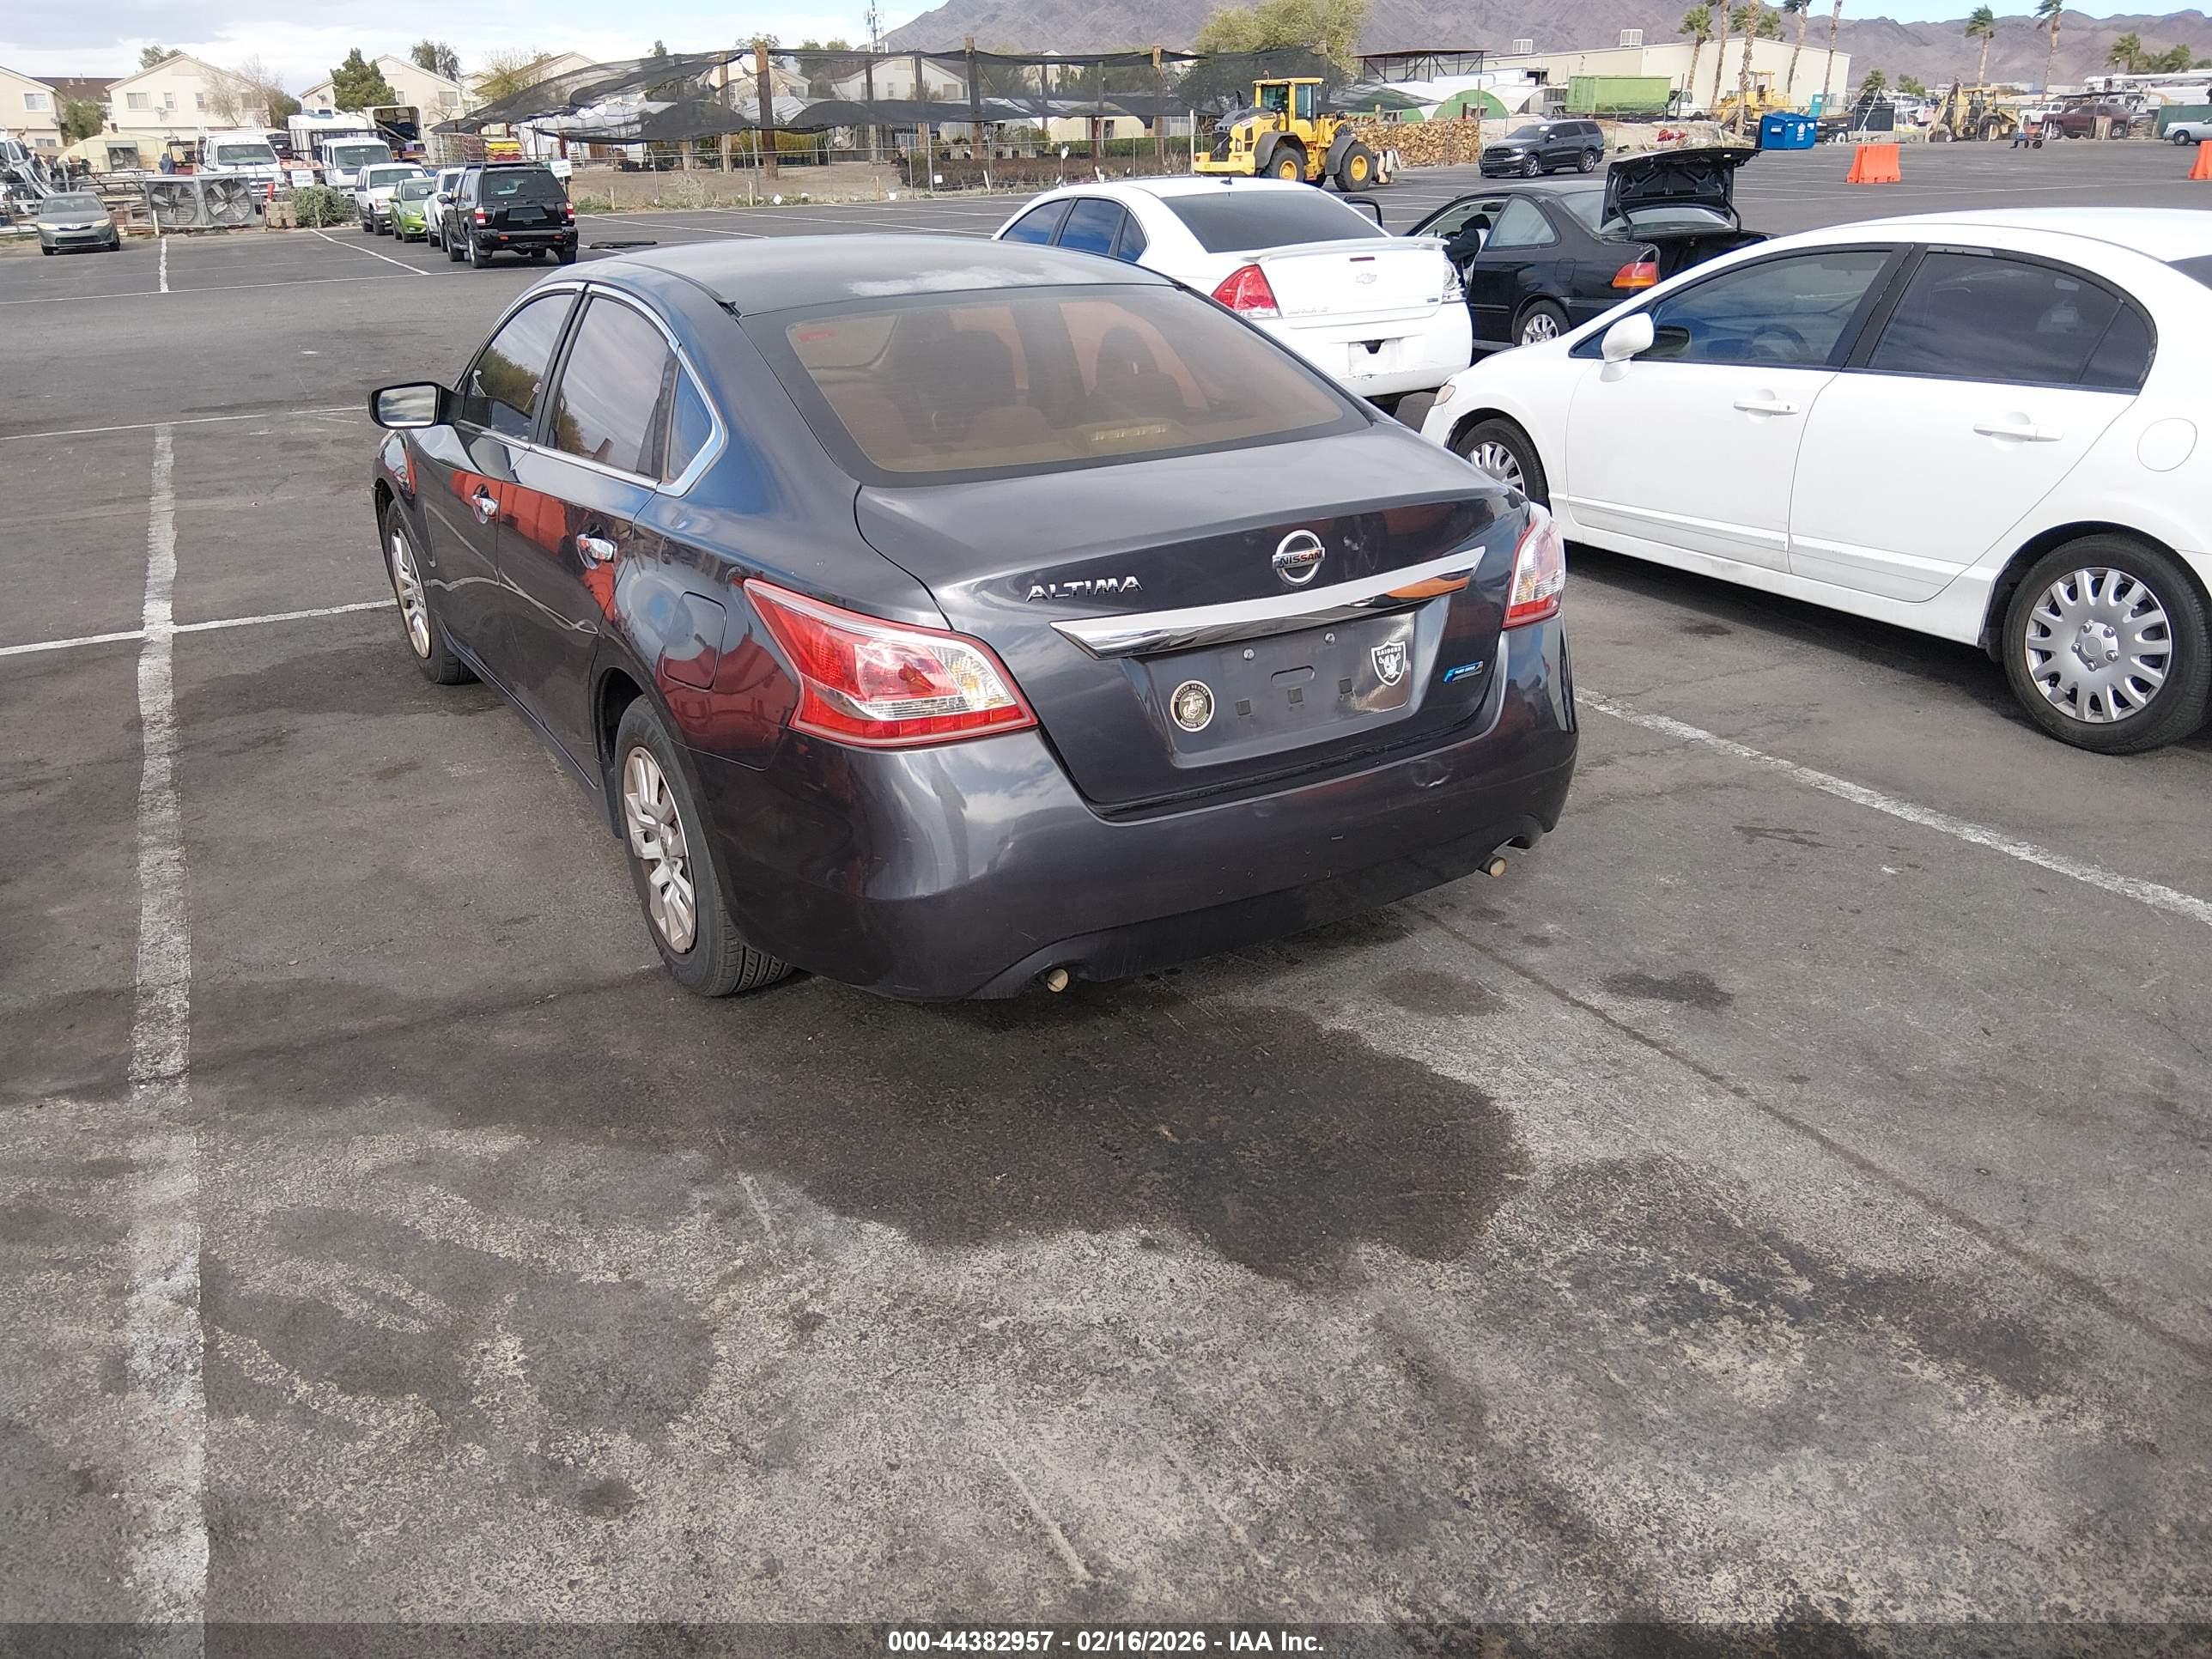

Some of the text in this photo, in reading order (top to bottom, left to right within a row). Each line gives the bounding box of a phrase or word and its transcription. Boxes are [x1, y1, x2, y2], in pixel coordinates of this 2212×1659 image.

[1279, 550, 1322, 565] NISSAN
[1025, 576, 1144, 603] ALTIMA
[1376, 646, 1401, 657] RAIDERS
[1176, 684, 1209, 702] UNITED STATES
[1180, 718, 1198, 728] MARINE
